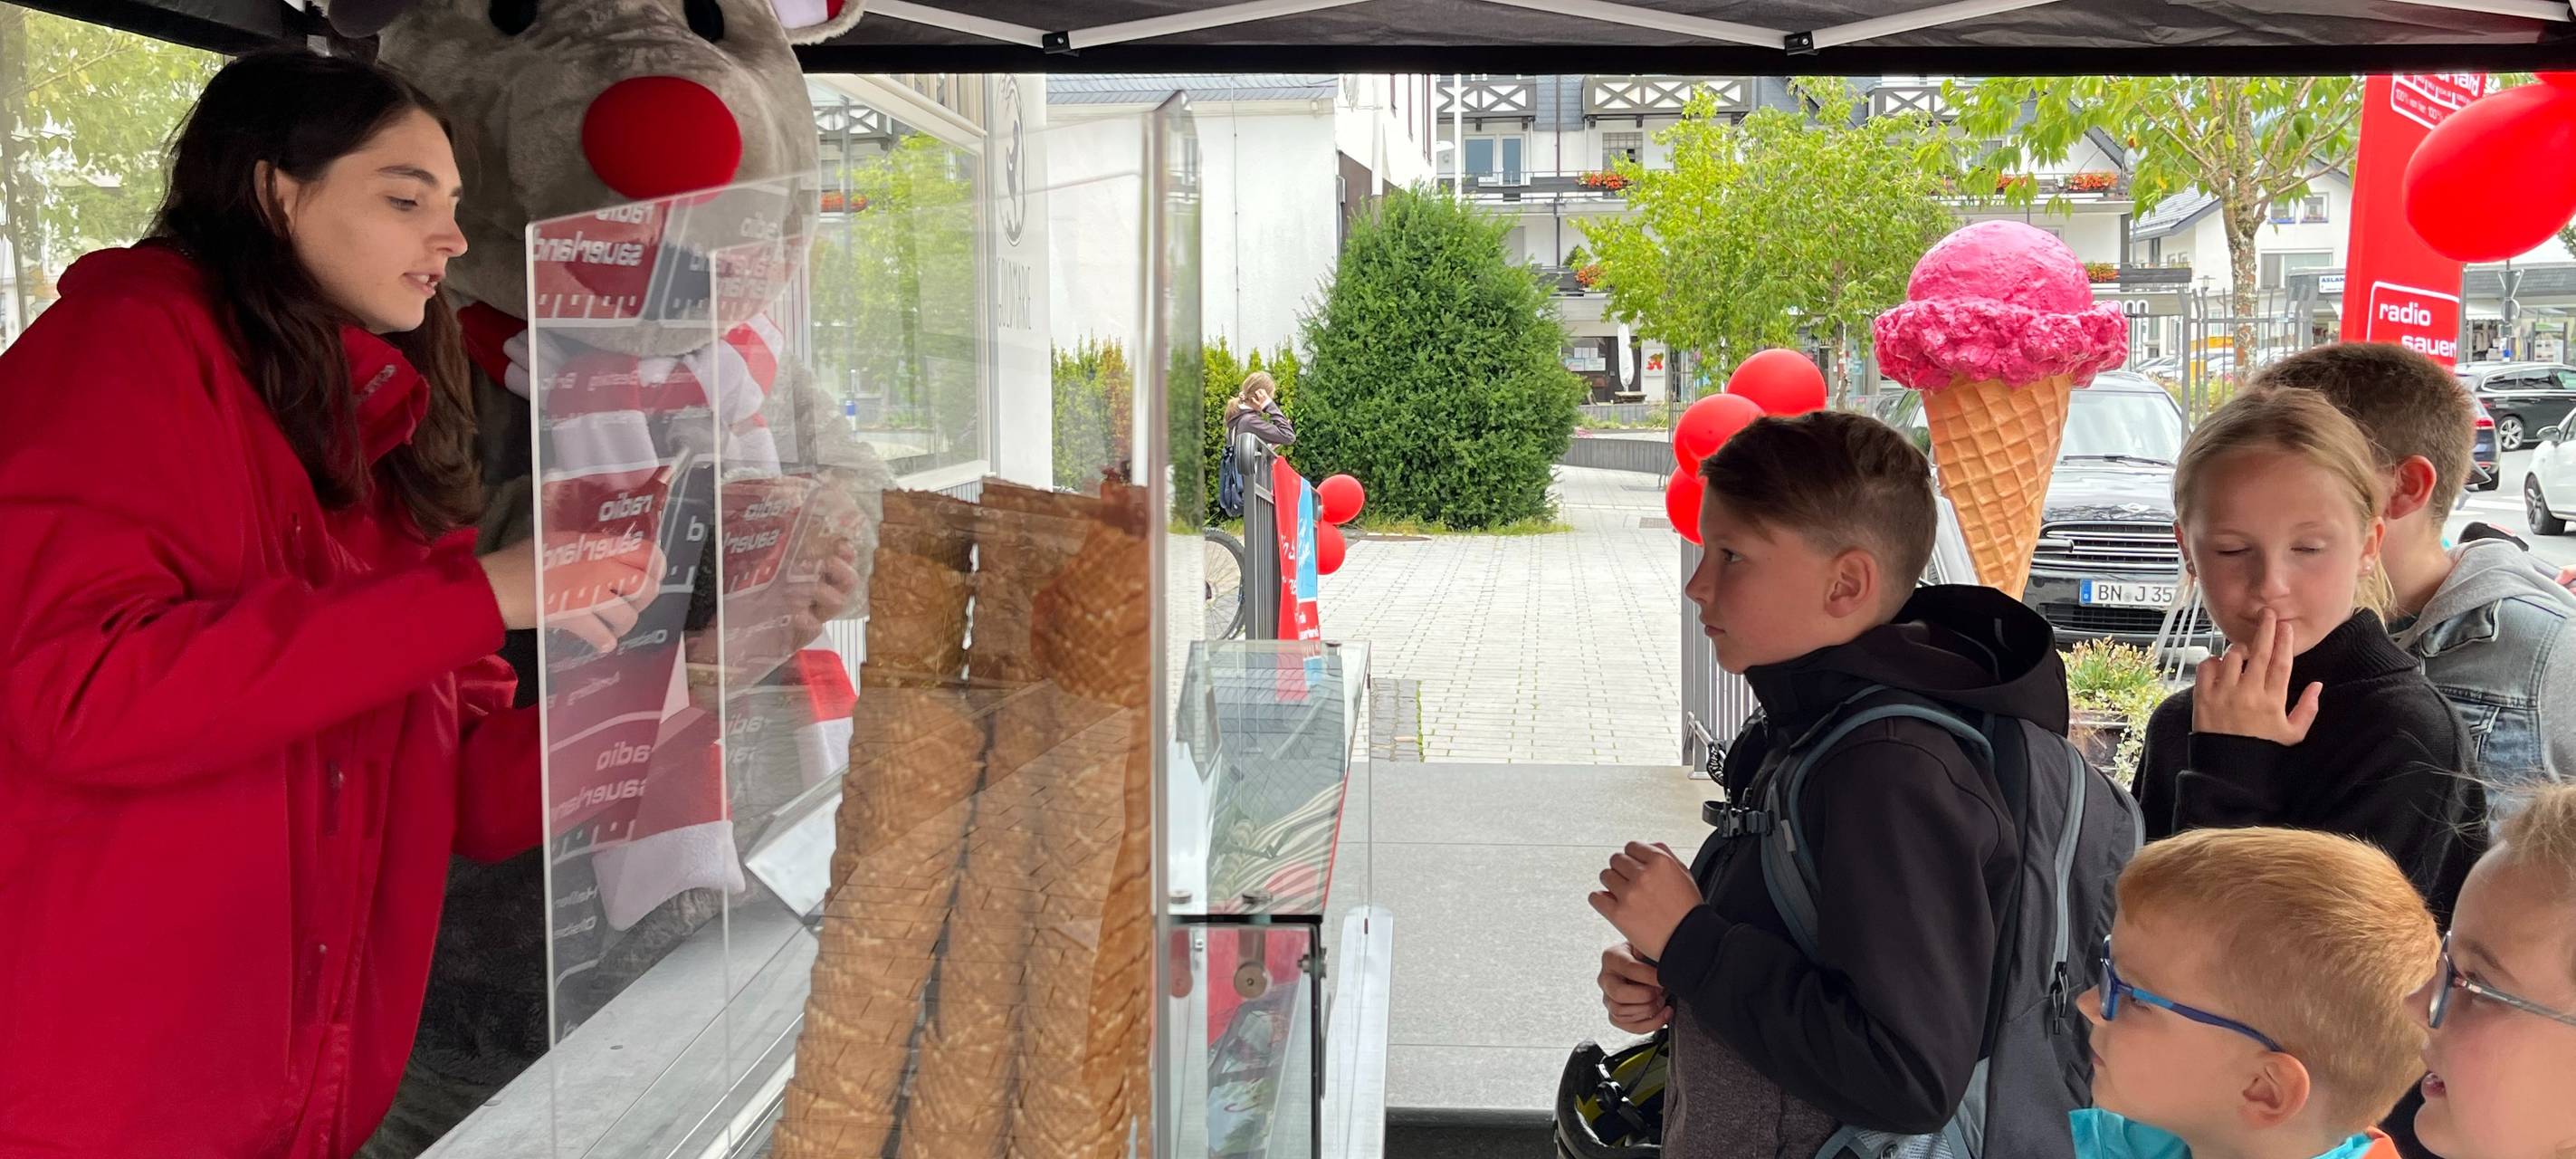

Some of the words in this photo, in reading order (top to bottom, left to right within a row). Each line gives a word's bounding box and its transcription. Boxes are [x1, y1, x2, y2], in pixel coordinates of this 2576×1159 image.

[2379, 302, 2431, 327] radio
[2098, 585, 2123, 601] BN
[2135, 586, 2146, 602] J
[2151, 586, 2174, 602] 35
